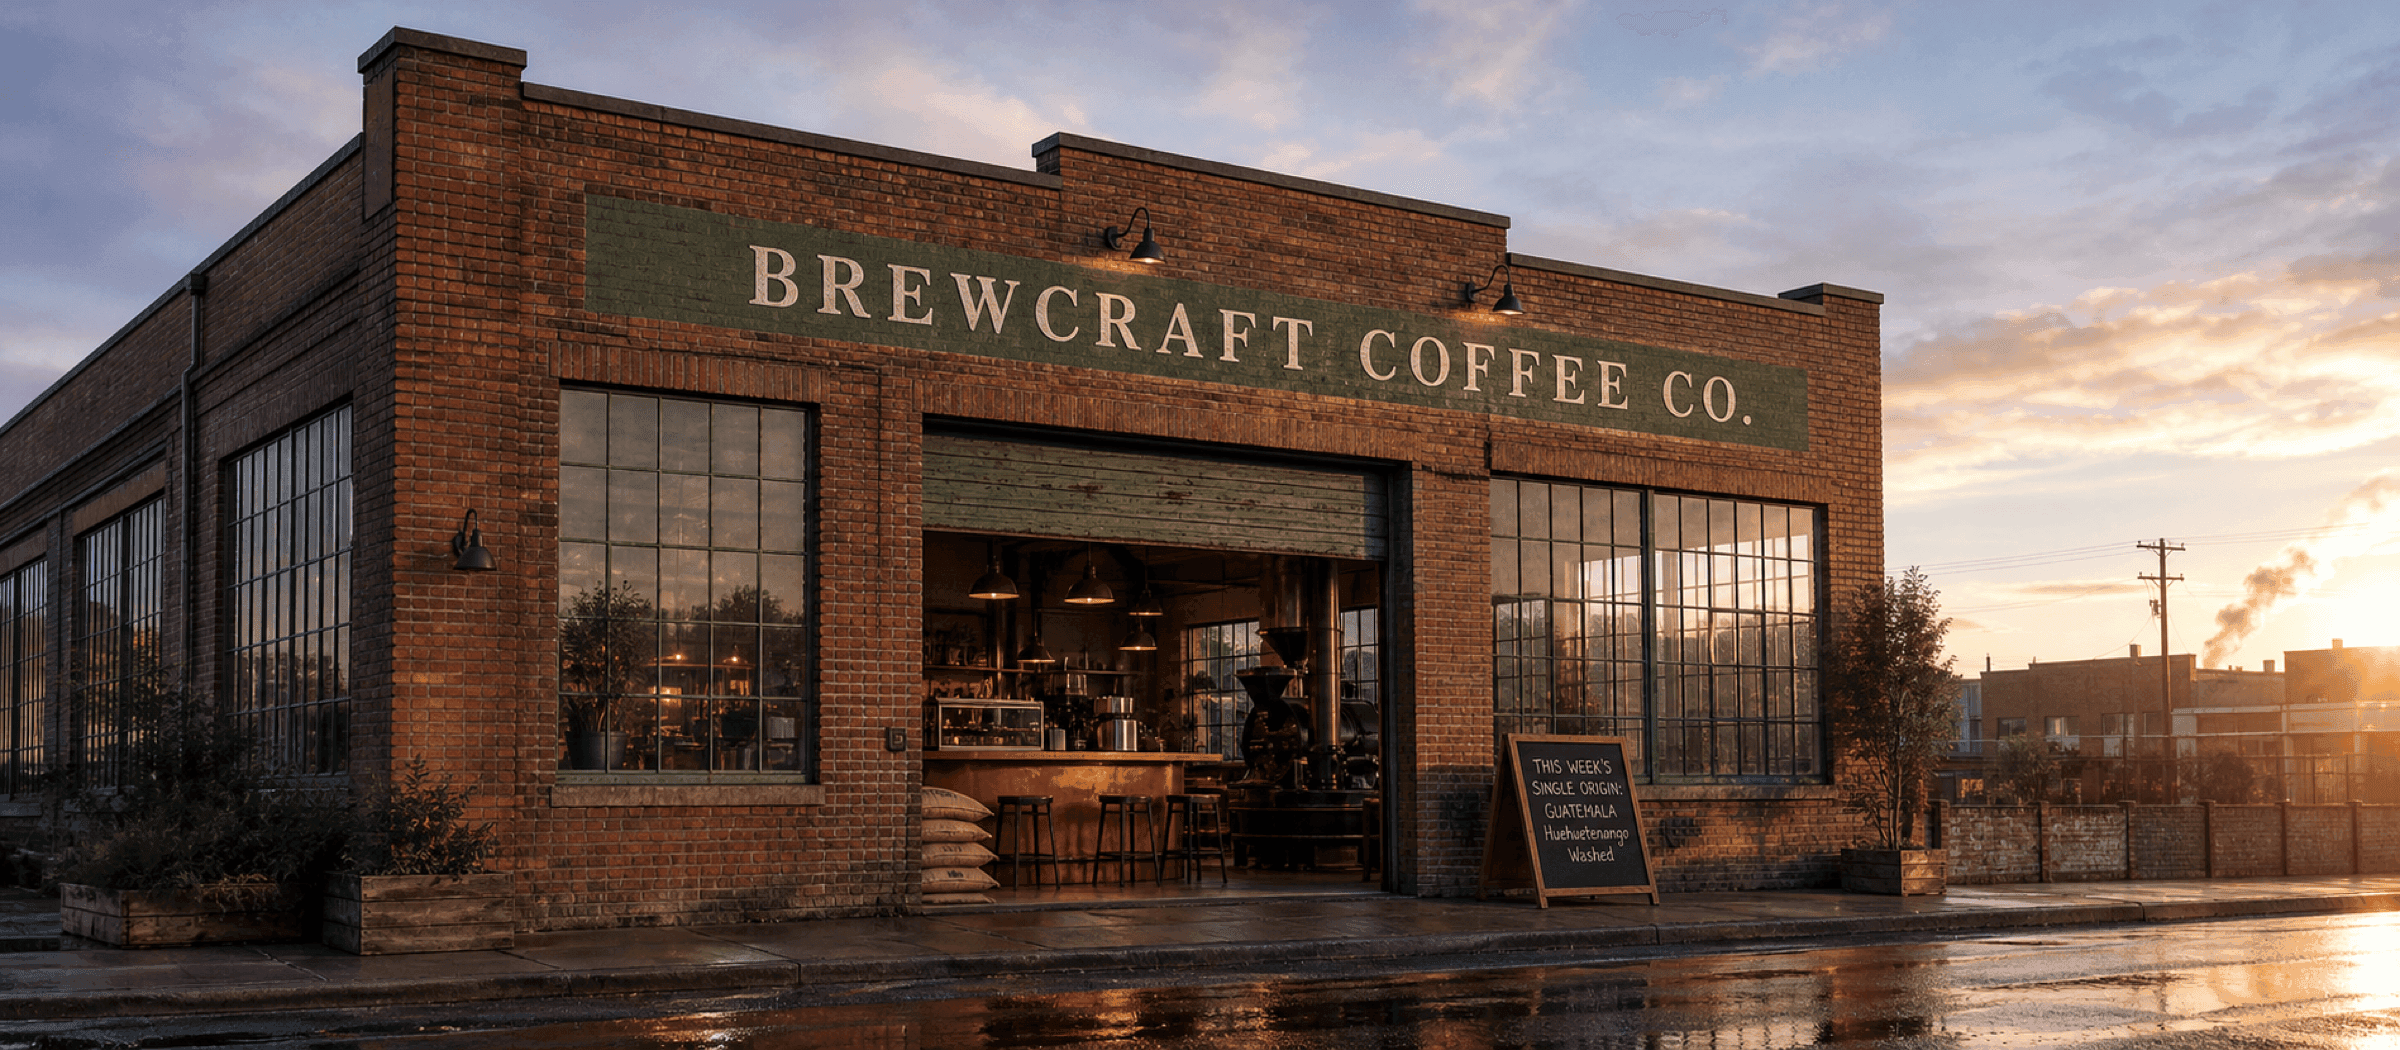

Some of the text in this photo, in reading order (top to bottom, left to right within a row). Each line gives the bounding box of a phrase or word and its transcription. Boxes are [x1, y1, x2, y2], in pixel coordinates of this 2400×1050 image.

[748, 244, 1753, 426] BREWCRAFT COFFEE CO.
[1532, 758, 1613, 775] THIS WEEK'S
[1531, 780, 1623, 796] SINGLE ORIGIN:
[1544, 803, 1618, 819] GUATEMALA
[1567, 845, 1615, 863] Washed
